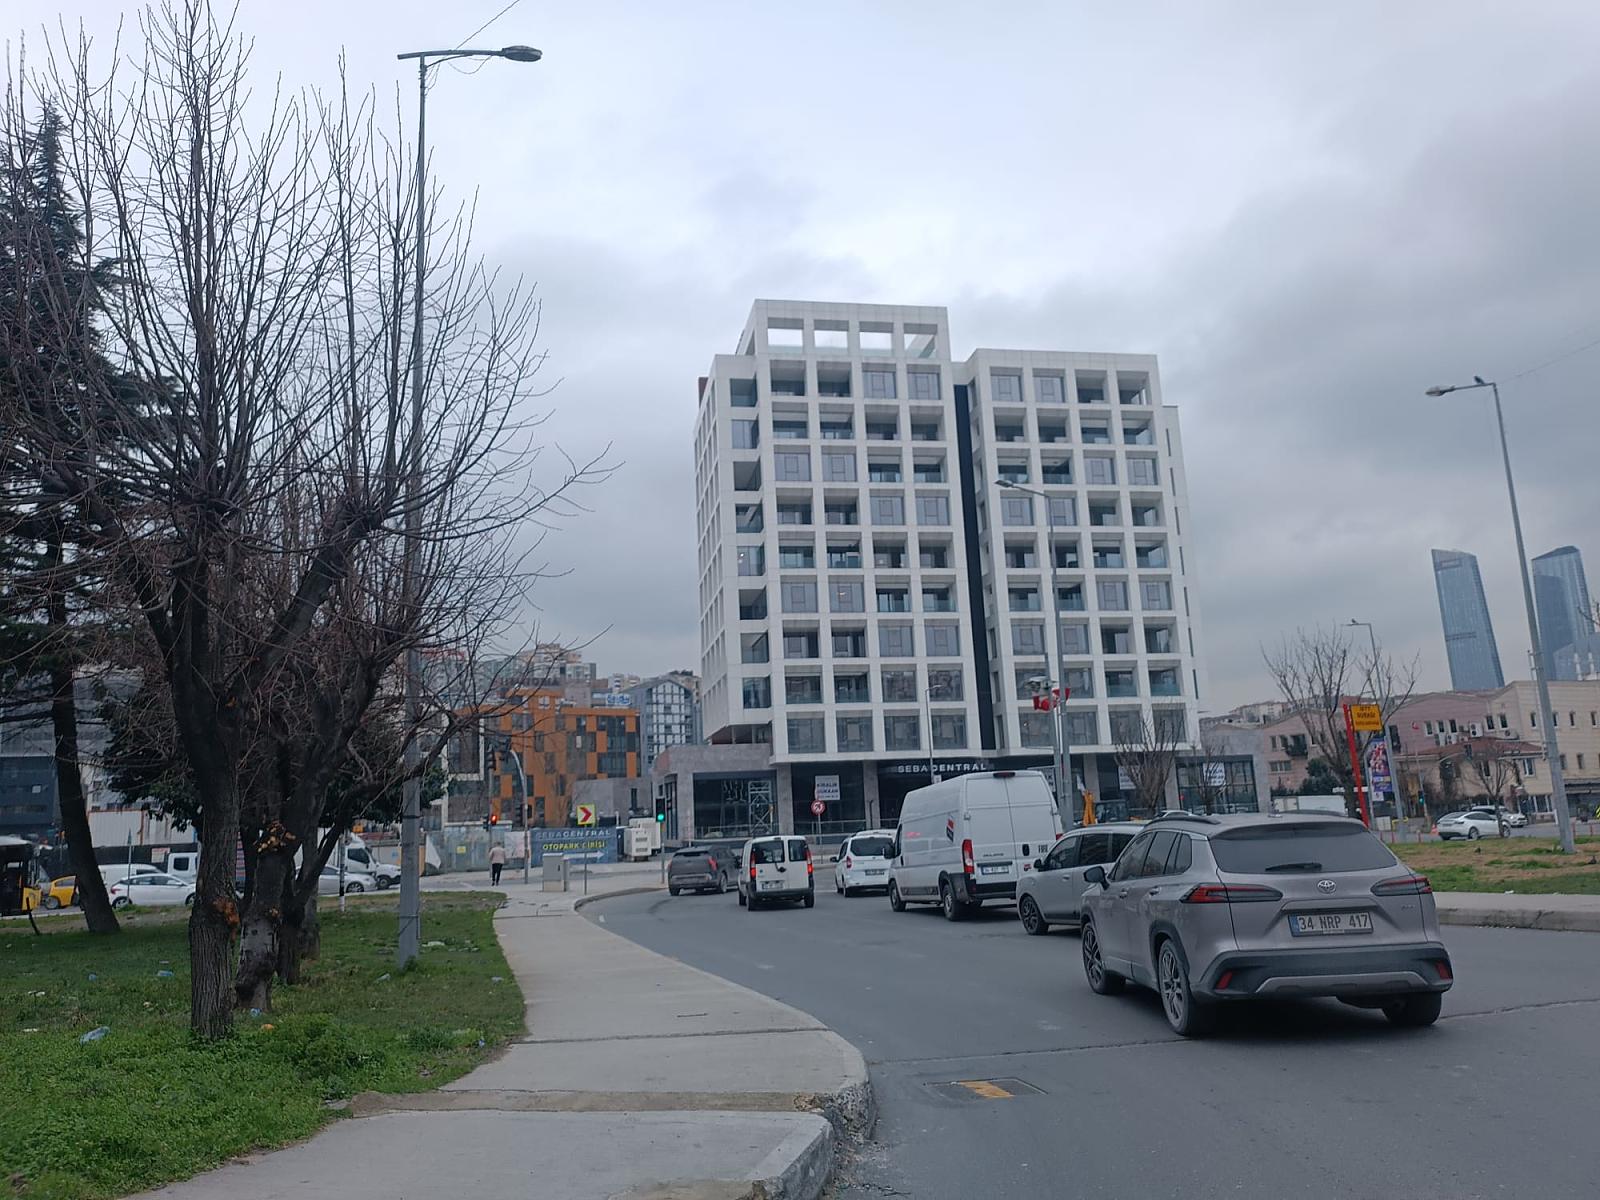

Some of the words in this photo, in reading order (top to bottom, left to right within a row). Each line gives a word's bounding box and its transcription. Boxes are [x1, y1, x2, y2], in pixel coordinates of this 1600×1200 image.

[542, 842, 580, 851] OTOPARK
[1298, 916, 1314, 930] 34
[1319, 915, 1342, 929] NRP
[1349, 914, 1368, 928] 417
